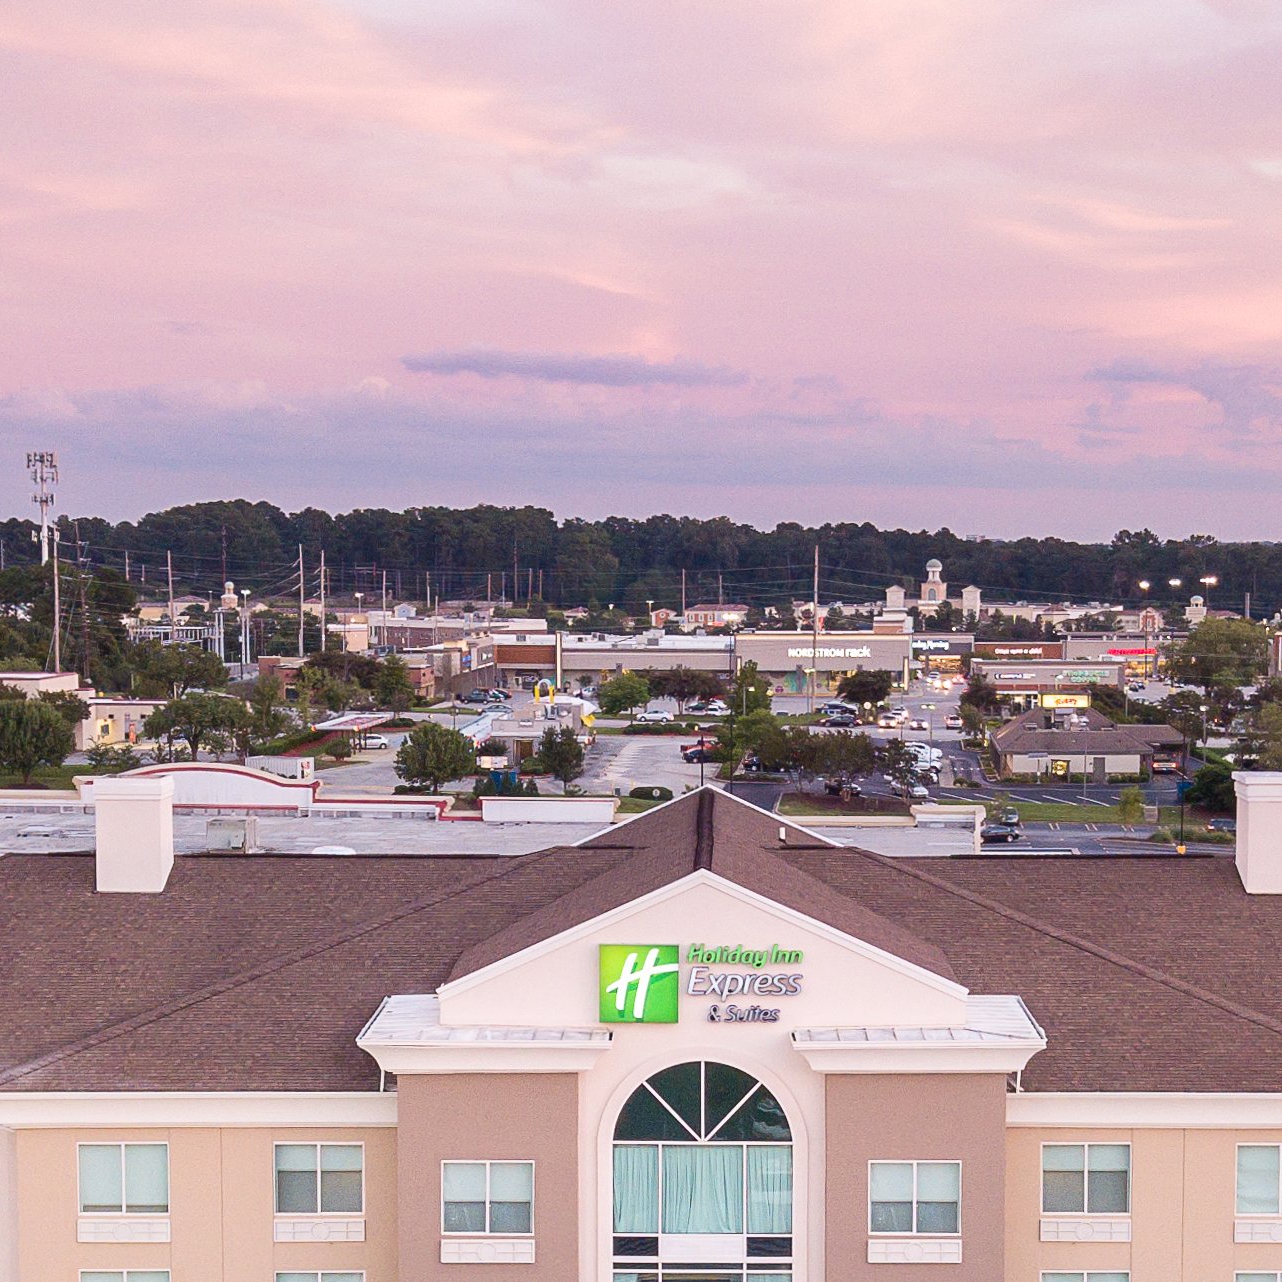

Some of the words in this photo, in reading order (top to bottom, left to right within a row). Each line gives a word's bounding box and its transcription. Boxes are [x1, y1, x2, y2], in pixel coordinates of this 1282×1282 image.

[787, 648, 845, 658] NORDSTROM
[845, 645, 872, 658] rack
[686, 943, 768, 968] Holiday
[770, 944, 804, 965] Inn
[687, 966, 804, 1003] Express
[706, 1004, 721, 1023] &
[723, 1004, 781, 1023] Suites
